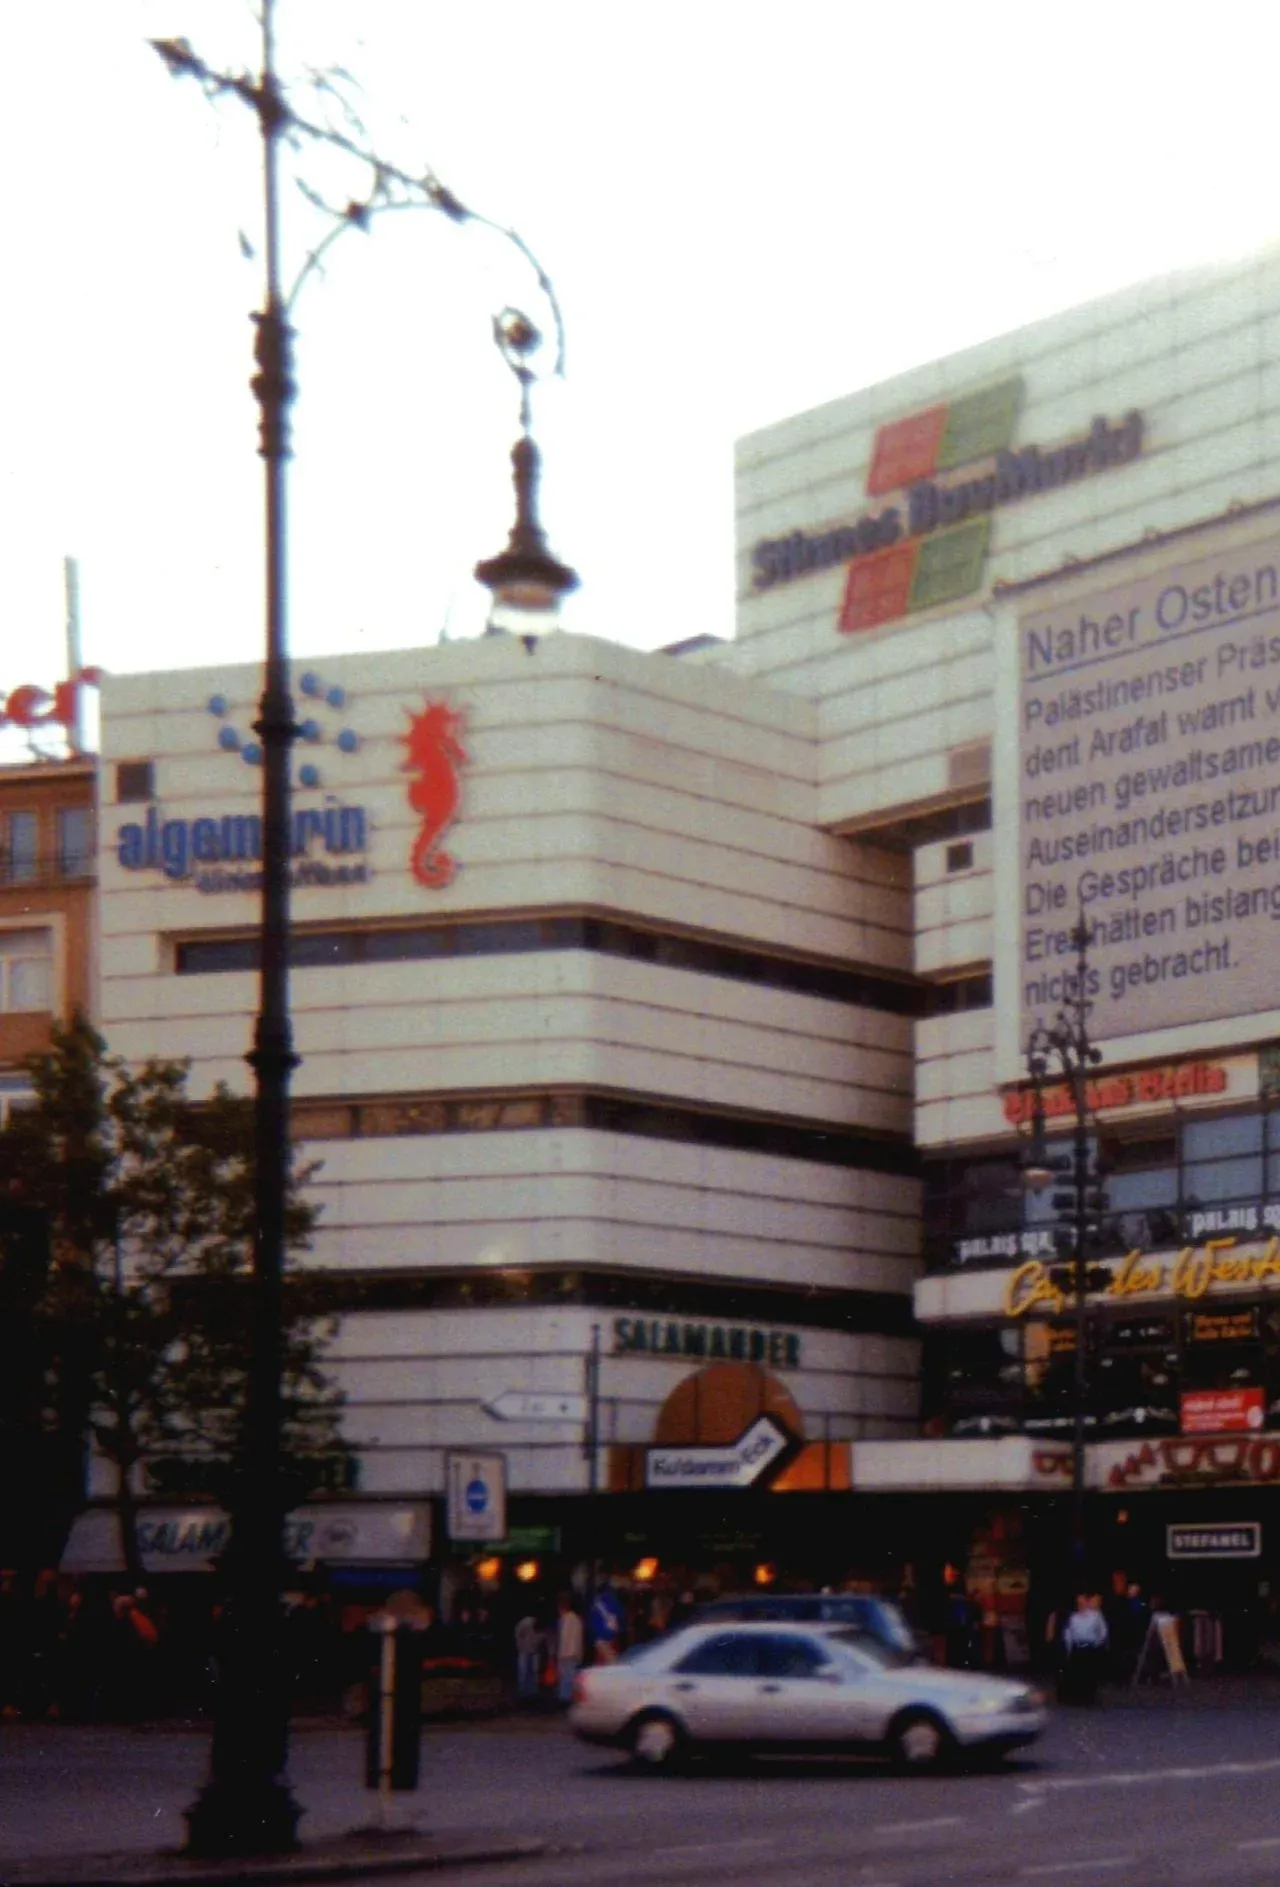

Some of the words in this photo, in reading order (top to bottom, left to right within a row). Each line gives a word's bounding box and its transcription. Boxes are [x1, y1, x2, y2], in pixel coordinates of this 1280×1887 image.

[1027, 607, 1140, 668] Naher
[1155, 565, 1277, 630] Osten
[1026, 656, 1206, 731] Palästinenser
[1026, 736, 1080, 779] dent
[1090, 710, 1168, 760] Arafat
[1178, 688, 1256, 735] warnt
[1026, 781, 1106, 822] neuen
[118, 797, 366, 877] algemrin
[1026, 883, 1067, 915] Die
[1078, 846, 1227, 903] Gespräche
[1089, 905, 1176, 947] hätten
[1026, 966, 1100, 1006] nichts
[1110, 936, 1240, 999] gebracht.
[614, 1317, 800, 1368] SALAMANDER
